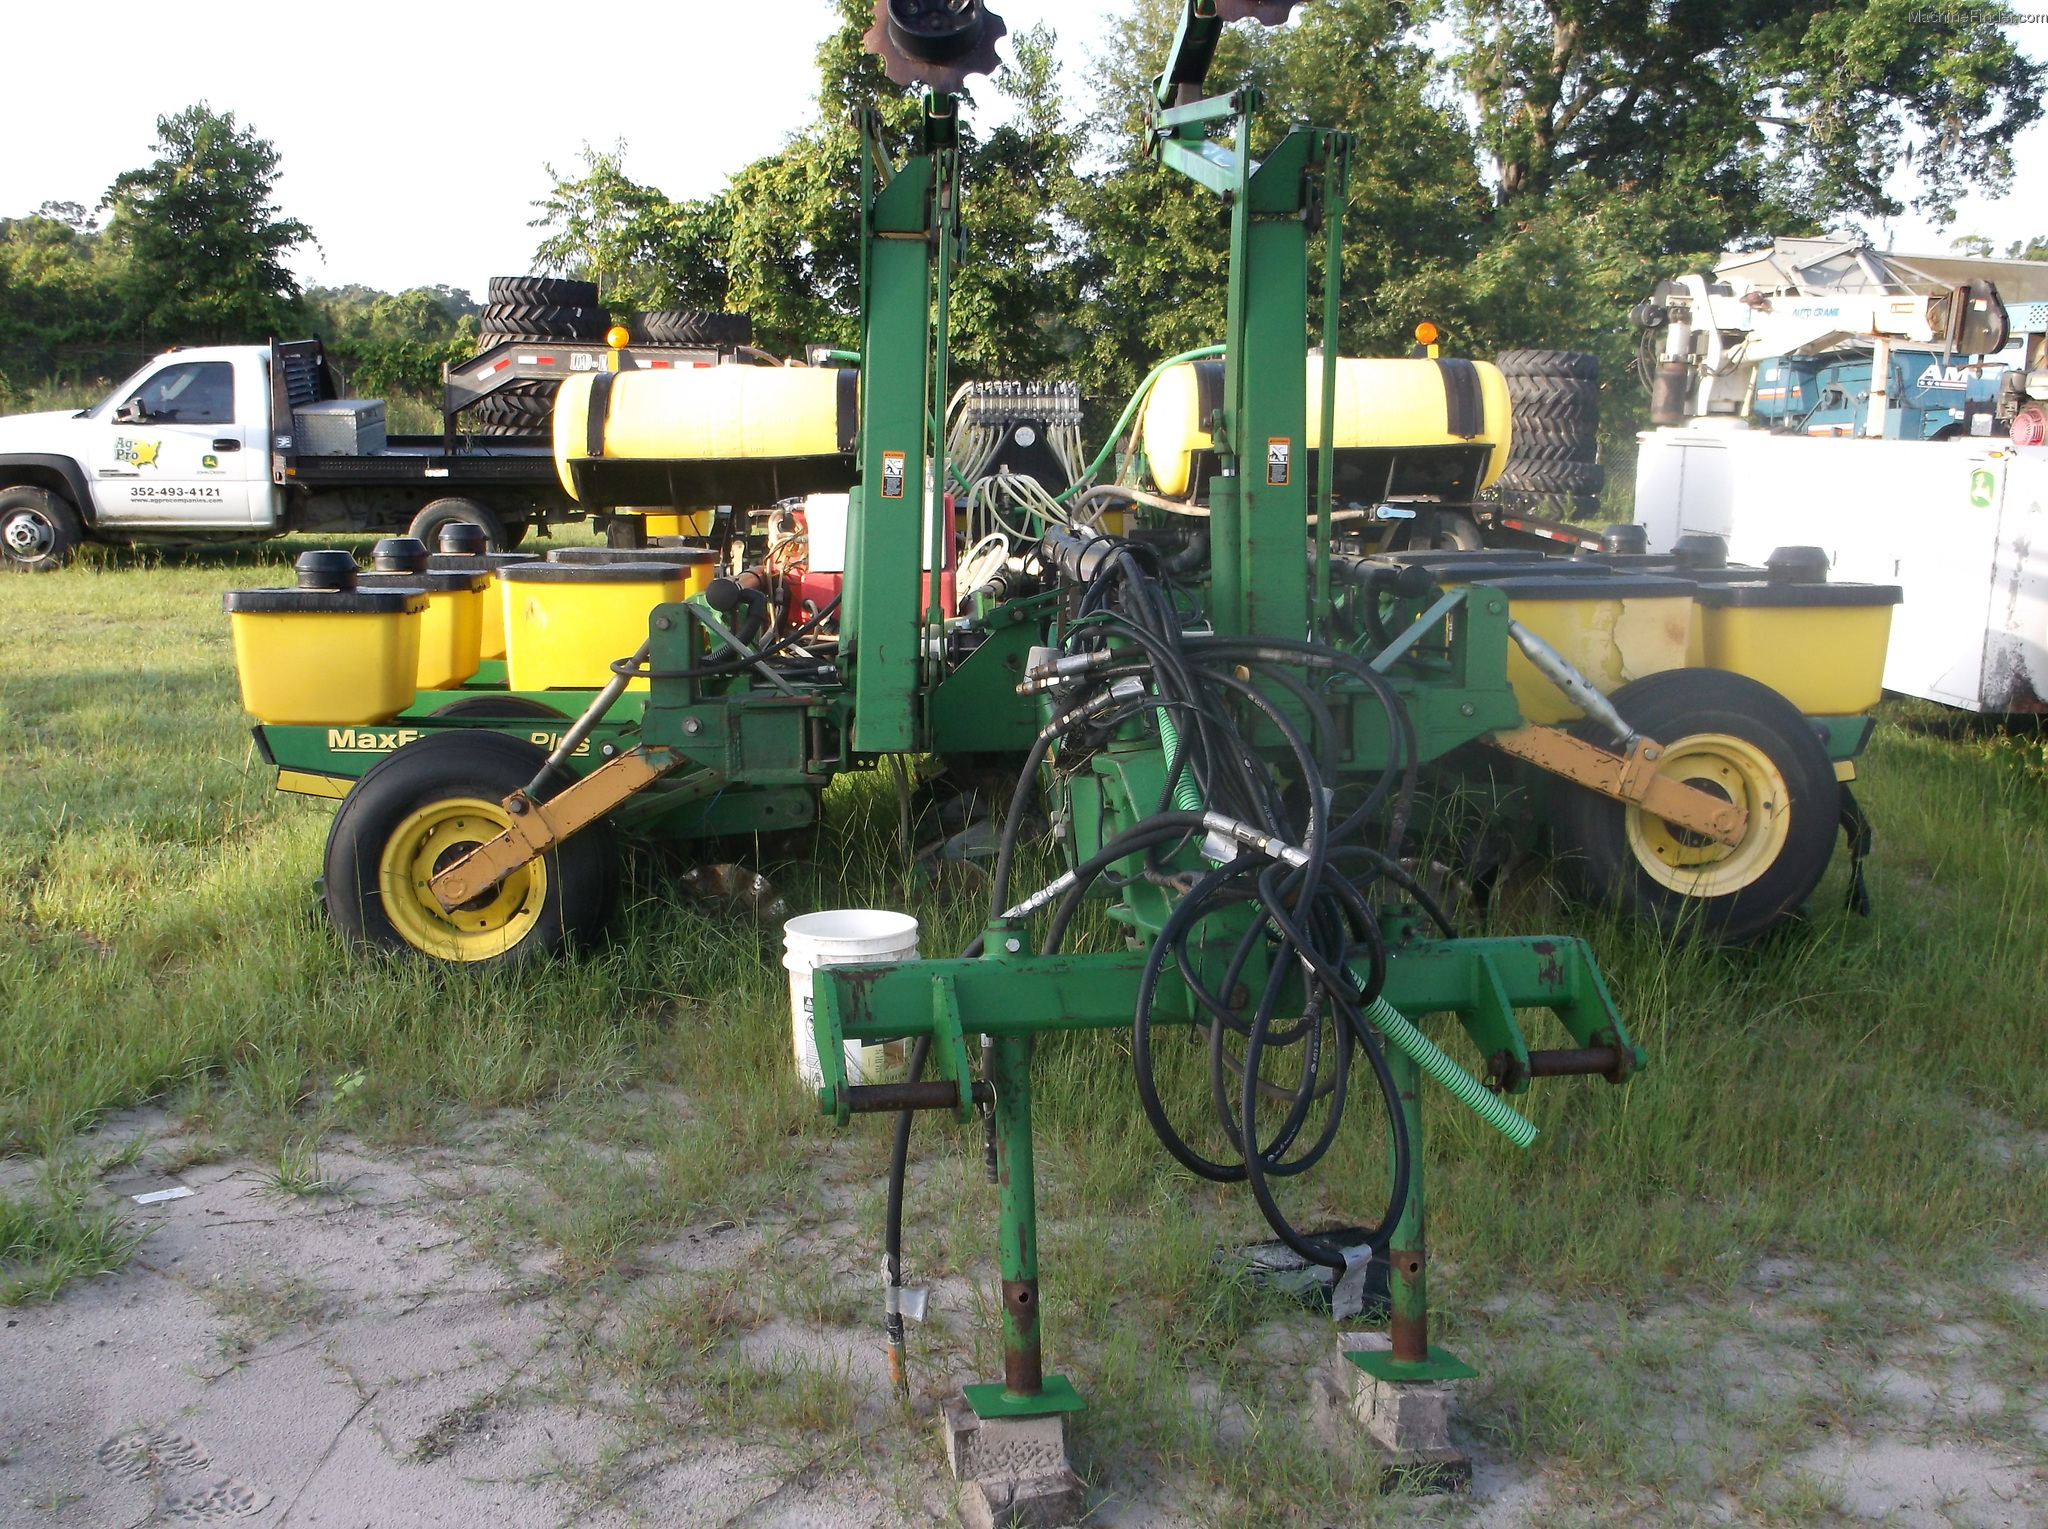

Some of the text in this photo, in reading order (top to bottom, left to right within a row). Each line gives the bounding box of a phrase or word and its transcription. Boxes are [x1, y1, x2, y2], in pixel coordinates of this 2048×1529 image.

[116, 437, 138, 451] Ag-
[116, 449, 139, 460] Pro
[130, 487, 220, 497] 352-493-4121
